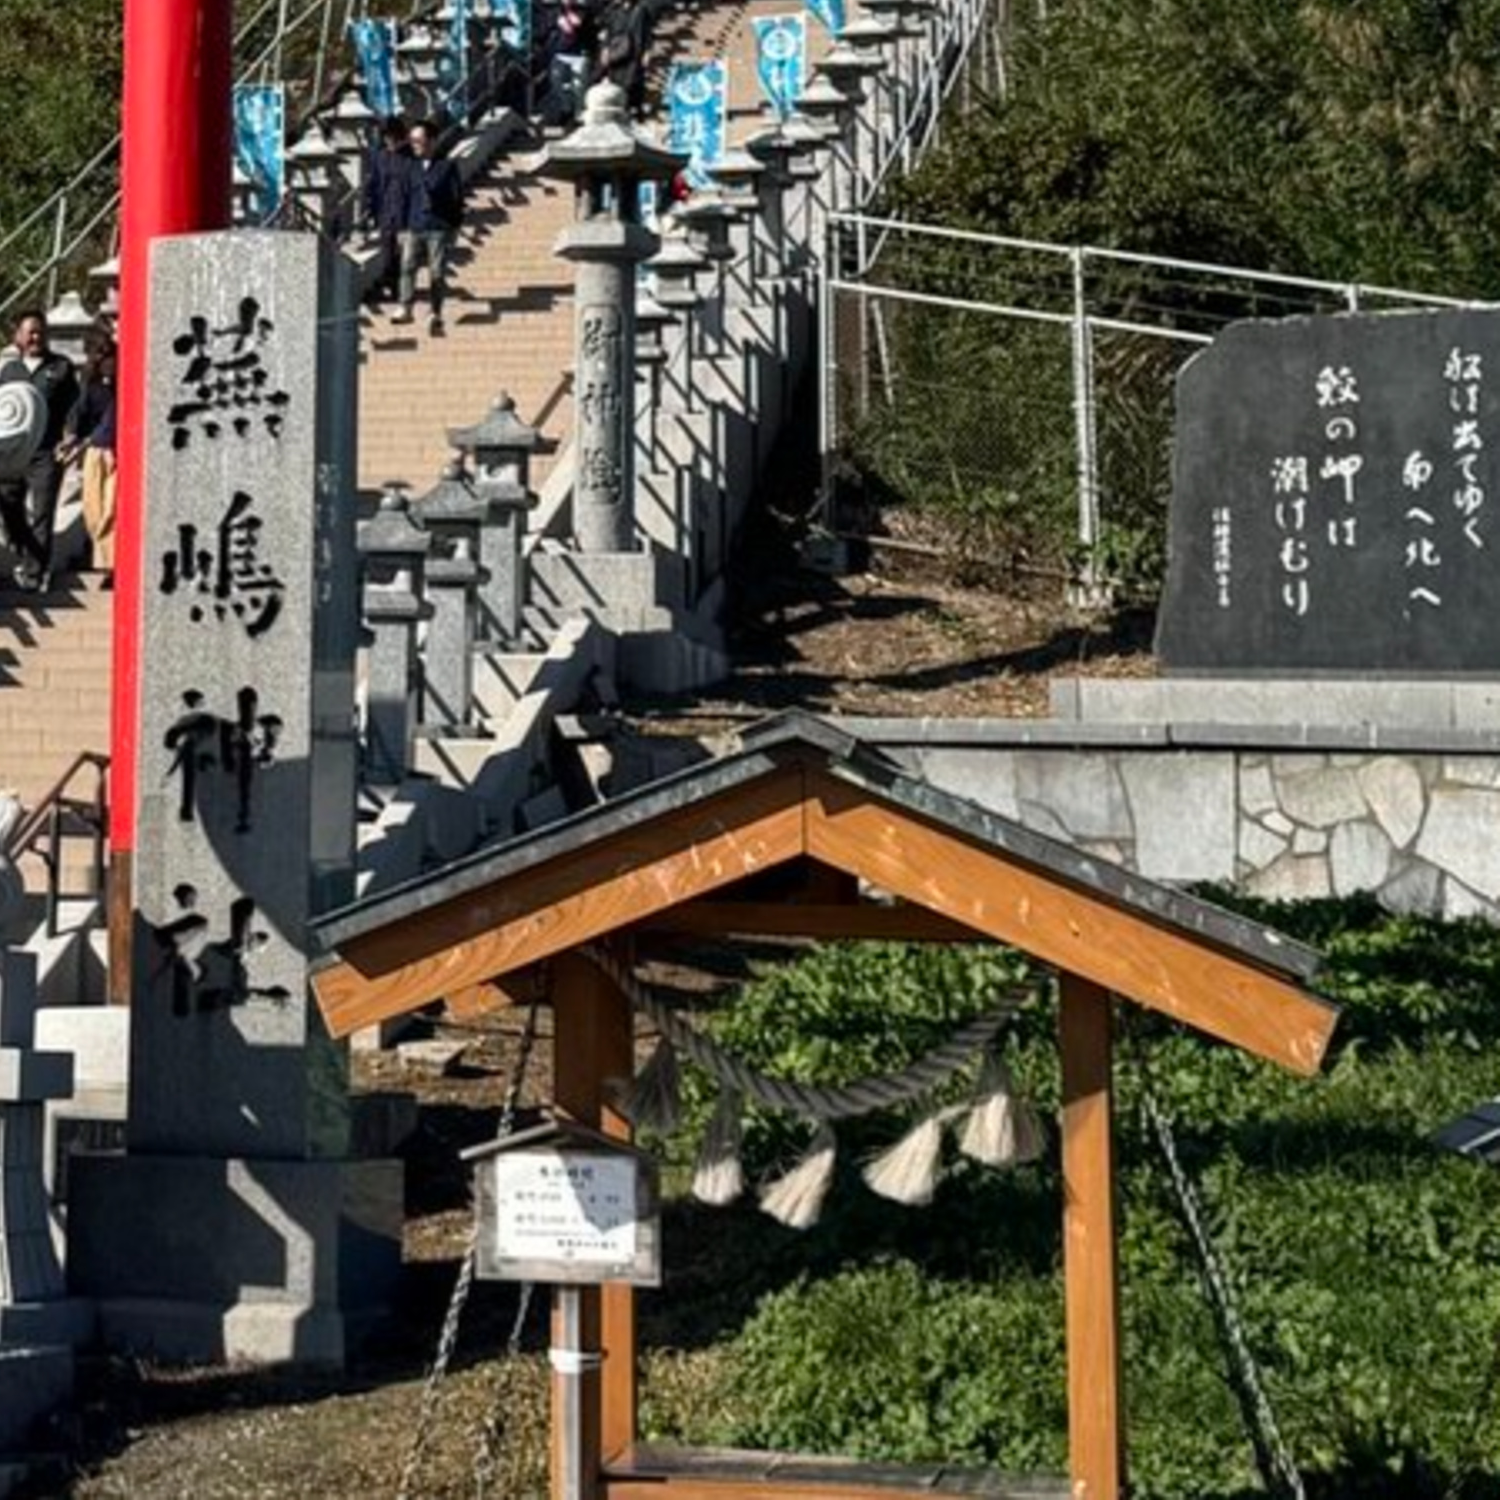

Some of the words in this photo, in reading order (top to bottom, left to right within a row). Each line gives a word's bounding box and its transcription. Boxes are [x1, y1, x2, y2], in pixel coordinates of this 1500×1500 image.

[1271, 456, 1309, 616] 潮けむり
[1316, 365, 1364, 547] 鮫の岬は
